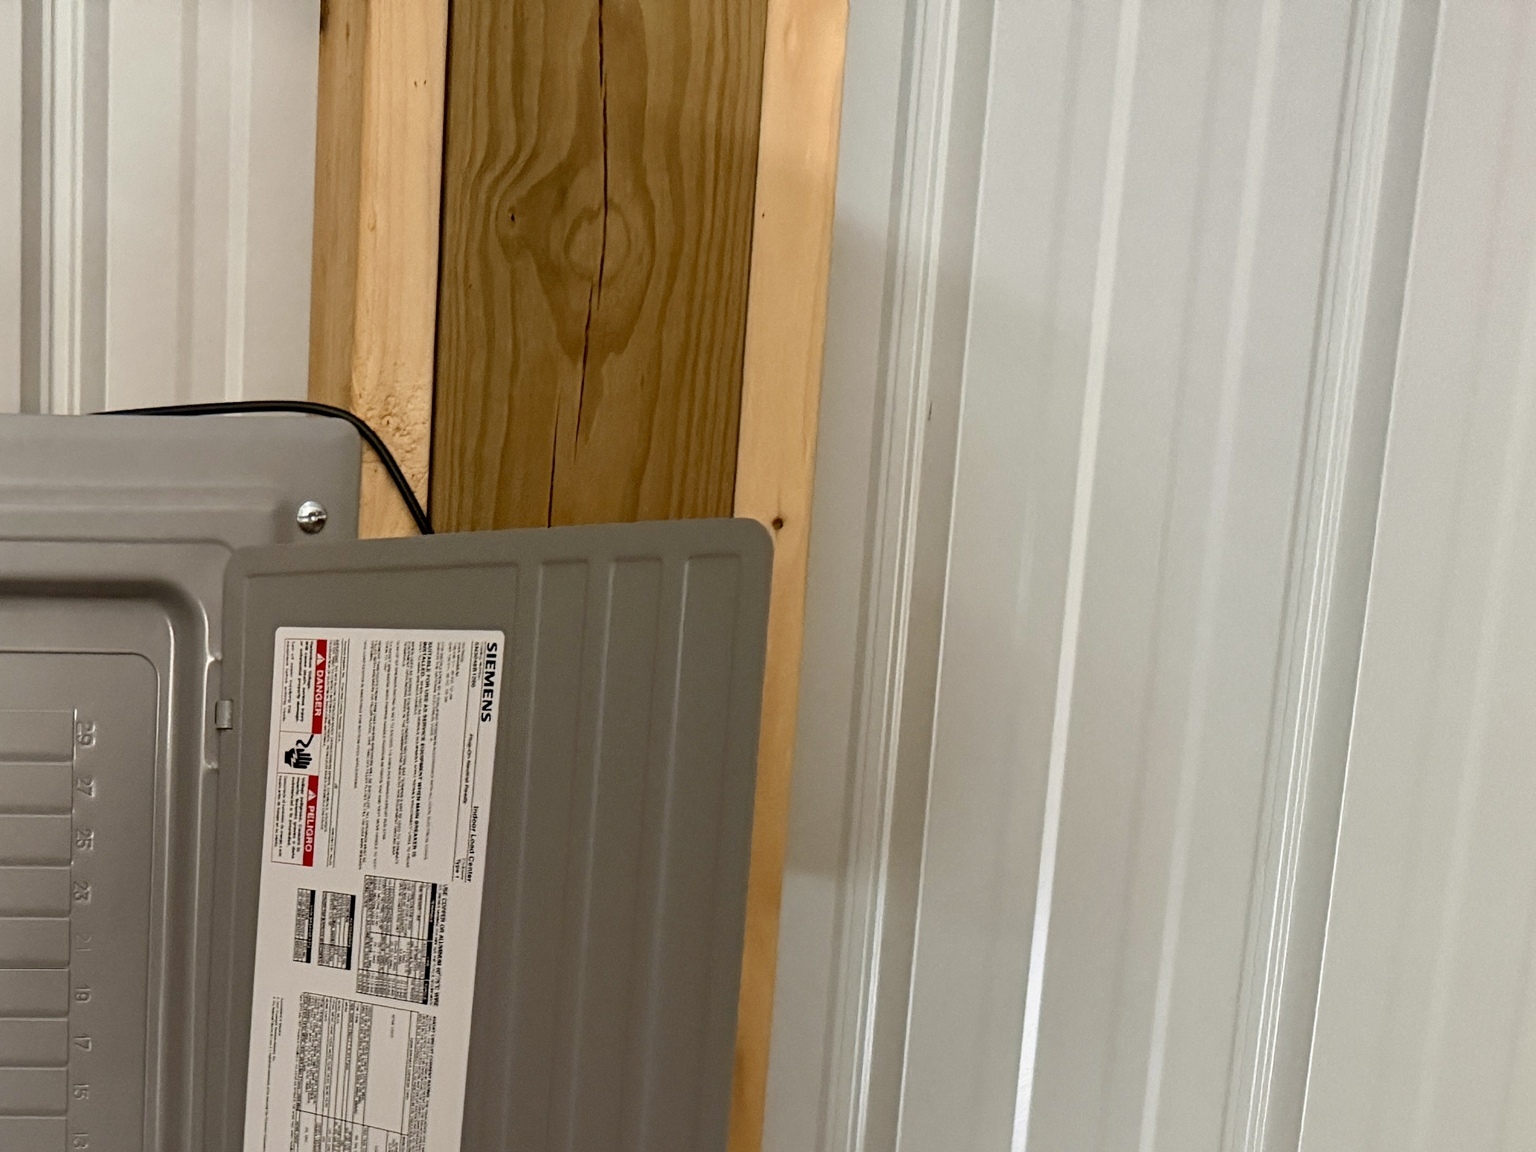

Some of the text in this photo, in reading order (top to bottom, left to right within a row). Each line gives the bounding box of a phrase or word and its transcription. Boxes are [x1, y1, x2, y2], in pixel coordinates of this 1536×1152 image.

[313, 669, 324, 716] DANGER
[480, 642, 498, 723] SIEMENS
[77, 776, 95, 798] 27
[76, 828, 94, 850] 25
[304, 804, 315, 852] PELIGRO
[466, 805, 479, 883] Indoor Load Center
[74, 881, 91, 902] 23
[74, 1034, 92, 1052] 17
